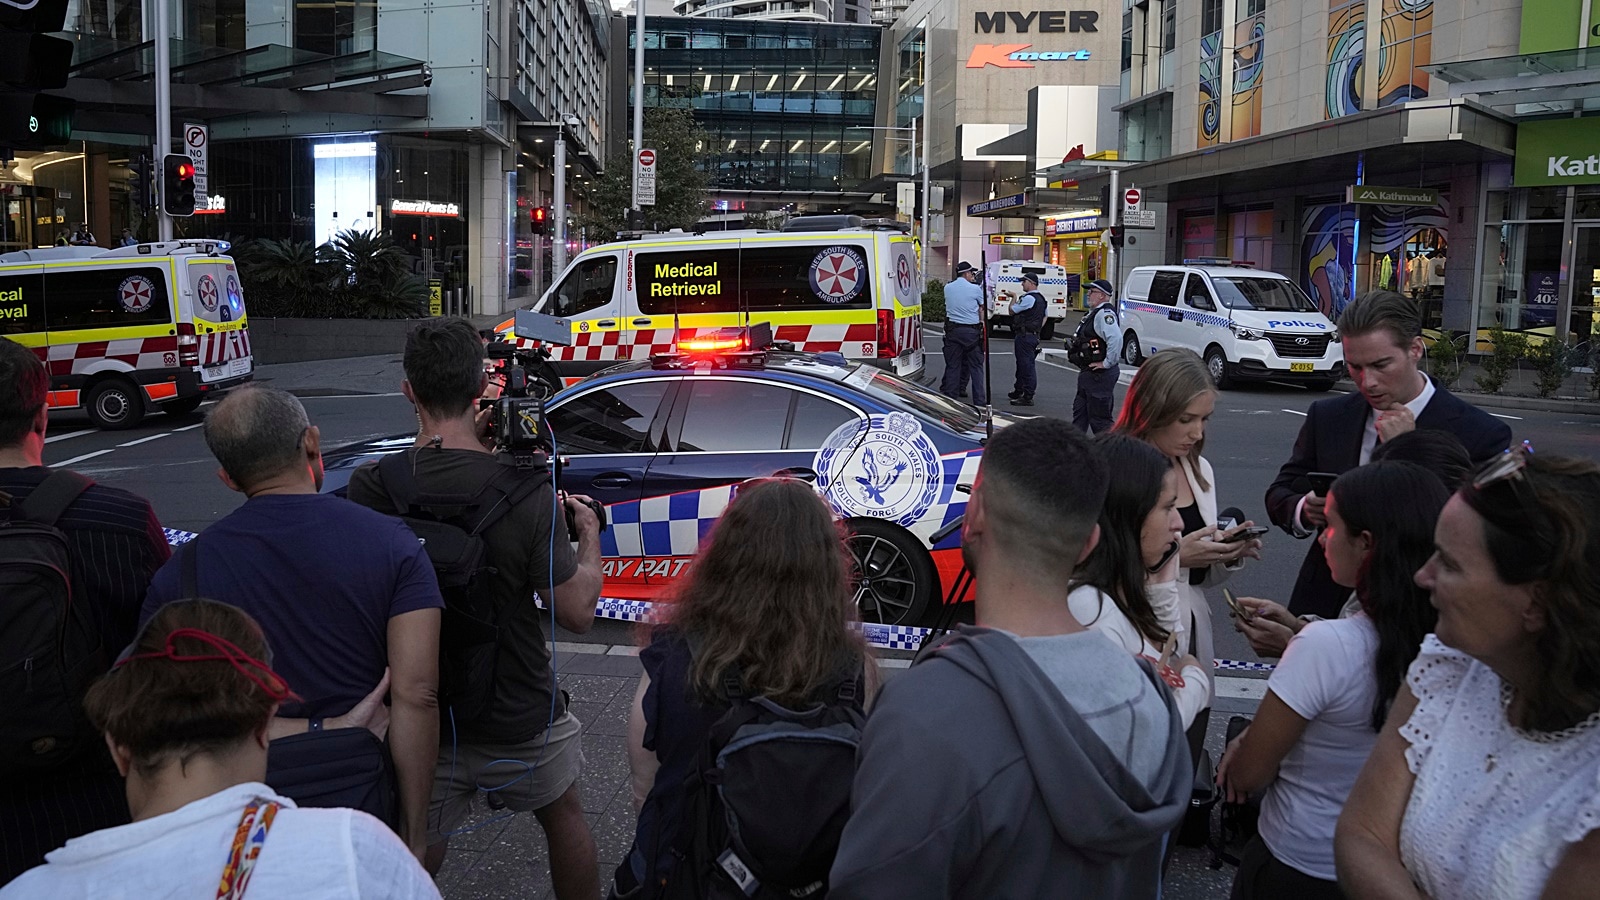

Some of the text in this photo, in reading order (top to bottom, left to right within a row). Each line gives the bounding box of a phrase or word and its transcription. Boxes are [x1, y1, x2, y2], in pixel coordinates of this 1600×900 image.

[975, 11, 1098, 33] MYER
[966, 43, 1091, 68] Kmart
[190, 149, 202, 158] NO
[1547, 153, 1600, 177] Kat
[972, 195, 1017, 213] CHEMIST WAREHOUSE
[1380, 191, 1431, 202] Kathmandu
[392, 200, 459, 215] General Pants Co.
[1056, 220, 1073, 232] CHEMIST
[811, 246, 864, 270] NEW SOUTH WALES
[655, 262, 718, 278] Medical
[650, 280, 721, 297] Retrieval
[816, 290, 857, 303] AMBULANCE
[1268, 320, 1326, 330] Police
[848, 434, 922, 478] NEW SOUTH WALES
[835, 481, 897, 517] POLICE FORCE
[601, 559, 692, 577] AY PAT
[604, 602, 643, 613] POLICE
[906, 635, 923, 643] PO
